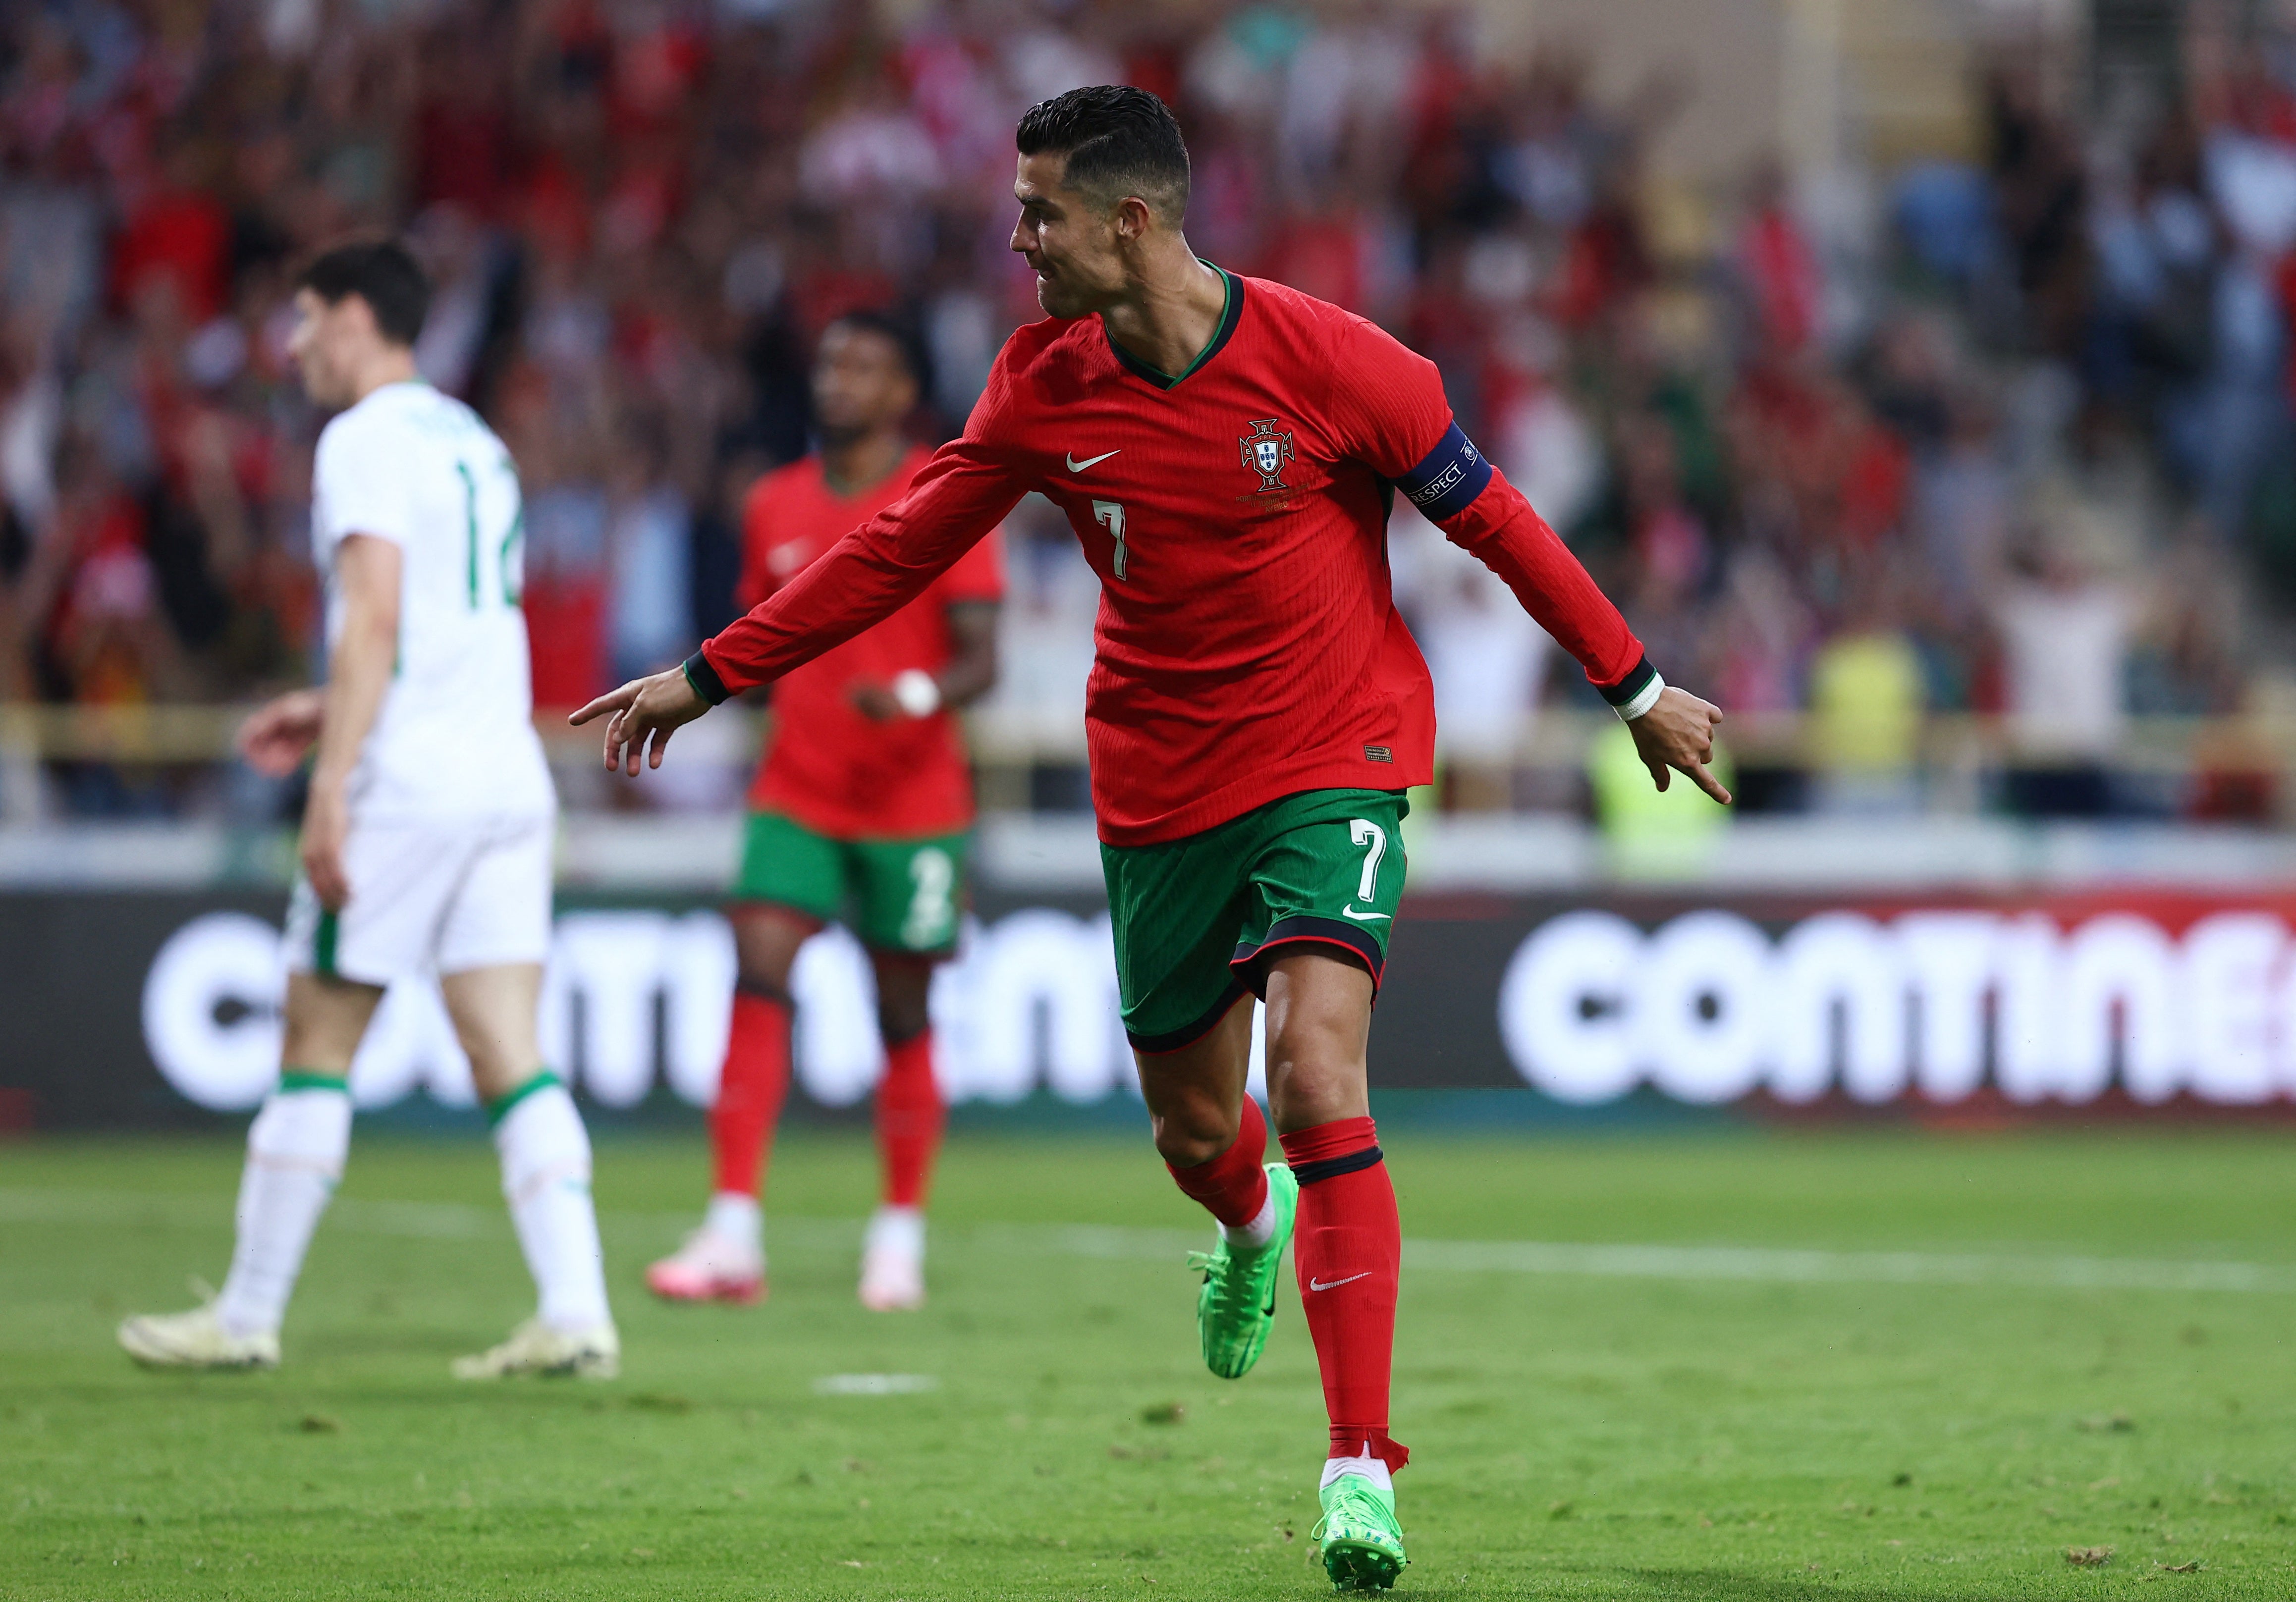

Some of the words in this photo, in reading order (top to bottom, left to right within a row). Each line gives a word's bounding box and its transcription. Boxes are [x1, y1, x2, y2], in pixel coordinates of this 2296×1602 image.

[1411, 464, 1461, 503] RESPECT
[1092, 499, 1128, 581] 7
[1349, 819, 1386, 903] 7
[1497, 908, 2296, 1107] CONTINE
